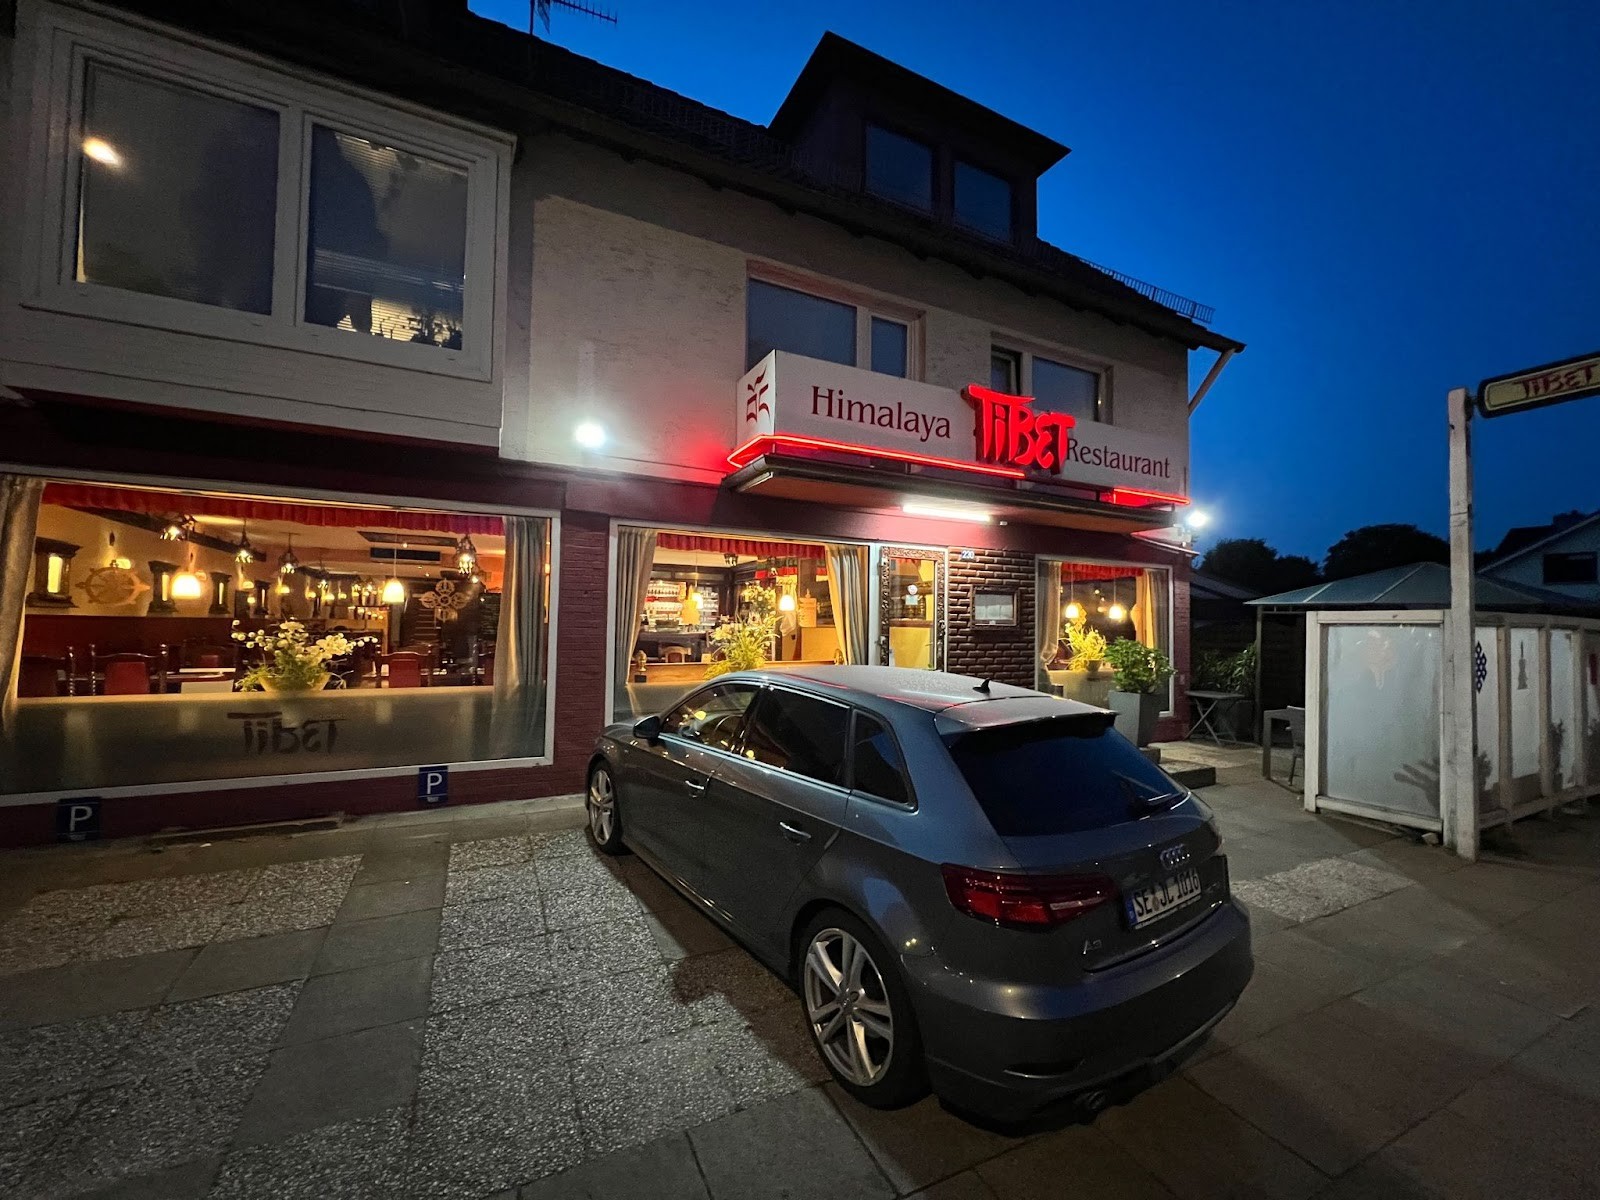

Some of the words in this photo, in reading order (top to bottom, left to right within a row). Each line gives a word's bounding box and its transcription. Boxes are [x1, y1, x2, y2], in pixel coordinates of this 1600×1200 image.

[811, 385, 951, 442] Himalaya
[1066, 437, 1171, 478] Restaurant
[427, 773, 443, 795] P
[70, 805, 93, 832] P
[1134, 889, 1152, 917] SE
[1177, 868, 1200, 900] 1016
